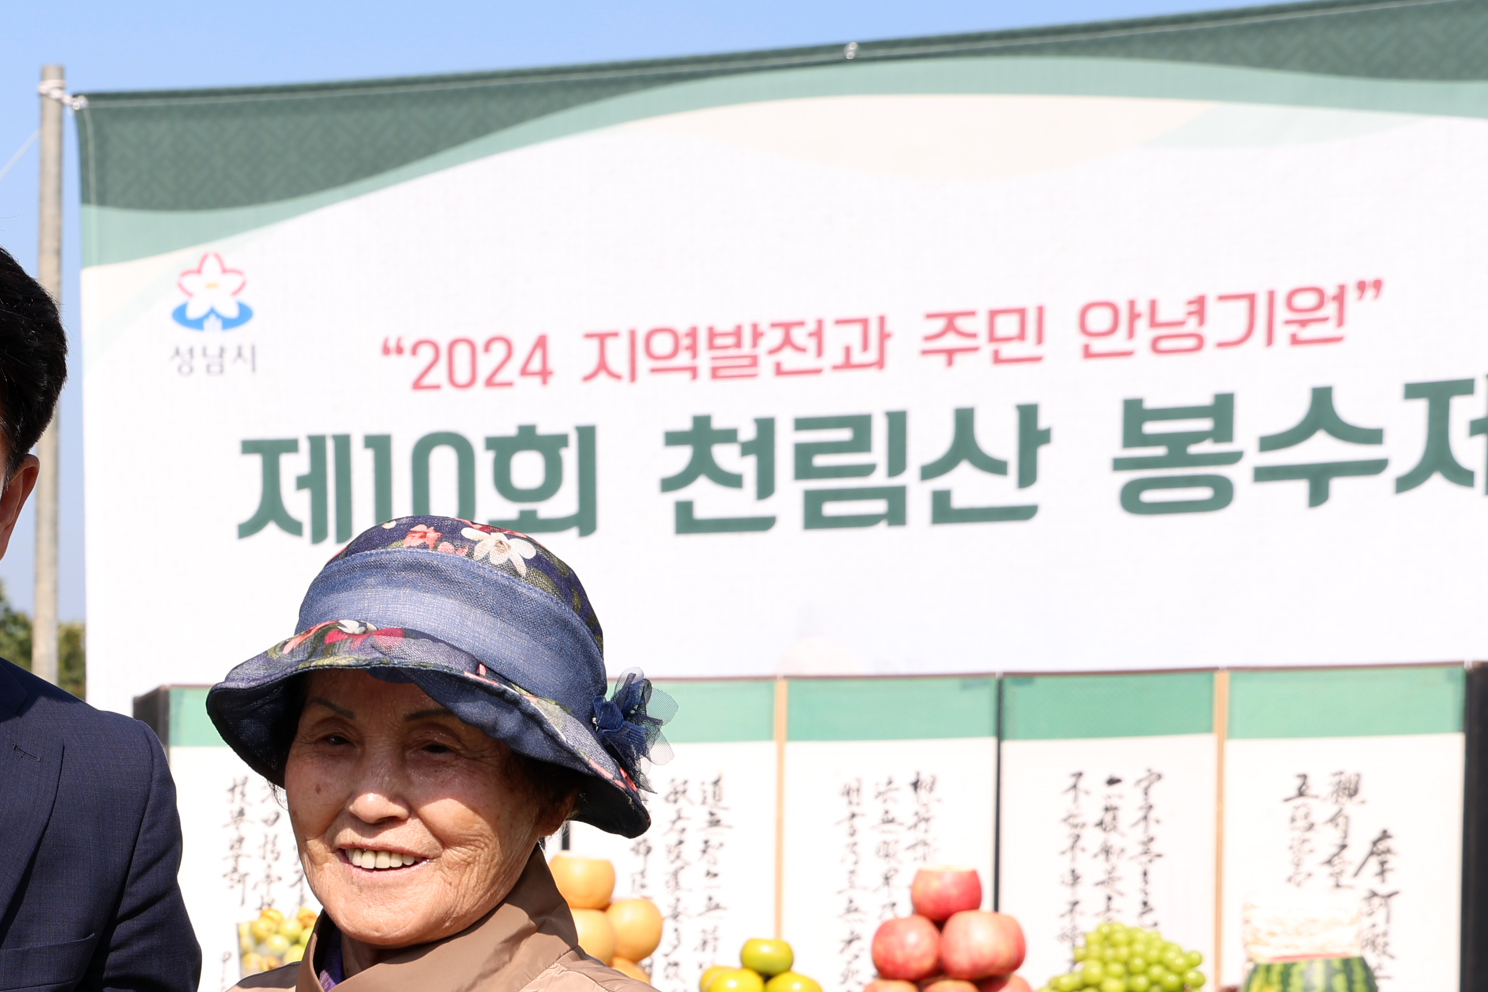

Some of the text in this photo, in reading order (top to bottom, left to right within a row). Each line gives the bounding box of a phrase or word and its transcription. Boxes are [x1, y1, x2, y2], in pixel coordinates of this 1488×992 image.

[169, 342, 258, 377] 성남시
[581, 313, 893, 384] 지역발전과
[919, 305, 1046, 369] 주민
[1079, 277, 1384, 361] 안녕기원”
[237, 421, 598, 545] 제10회
[659, 401, 1053, 536] 천림산
